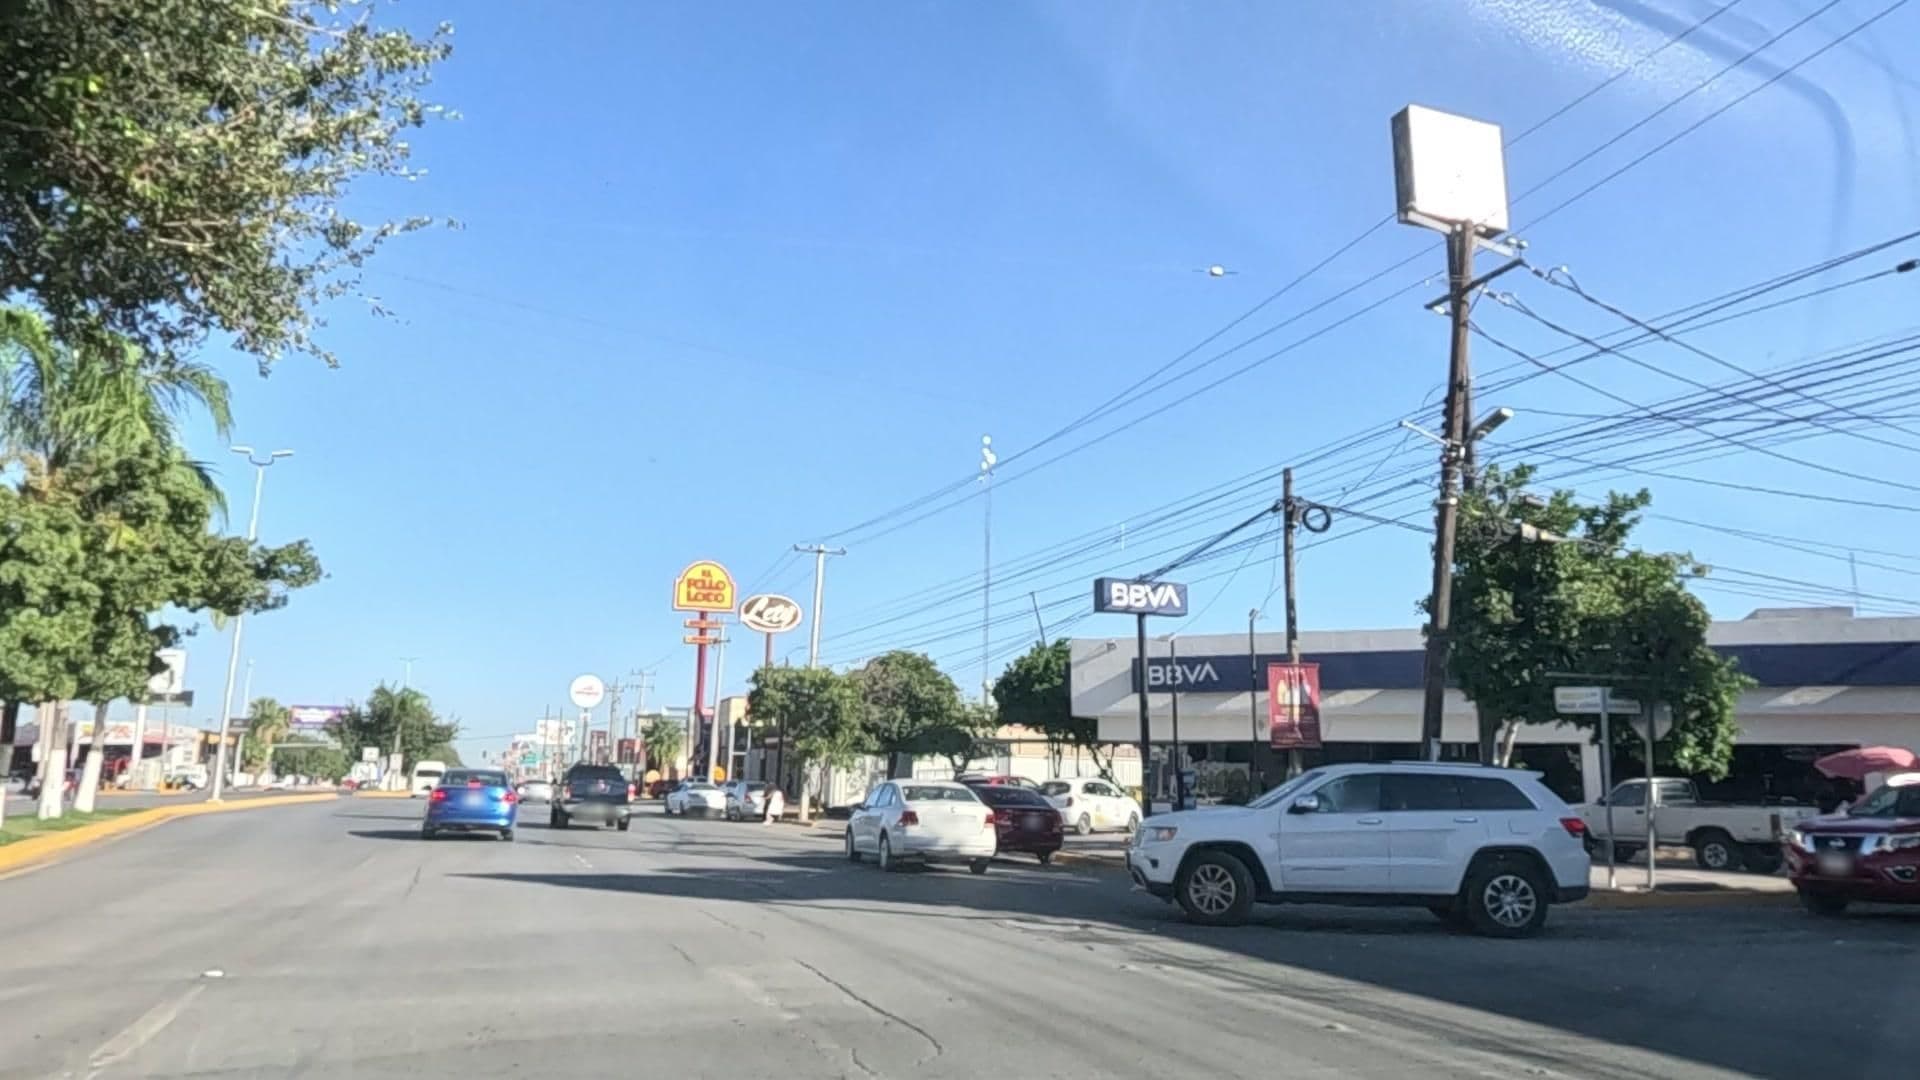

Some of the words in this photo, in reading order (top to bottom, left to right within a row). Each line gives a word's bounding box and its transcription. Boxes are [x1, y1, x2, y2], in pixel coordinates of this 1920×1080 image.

[687, 578, 726, 590] POLLO
[686, 590, 725, 603] LOCO
[1111, 582, 1181, 609] BBVA
[1148, 661, 1219, 686] BBVA
